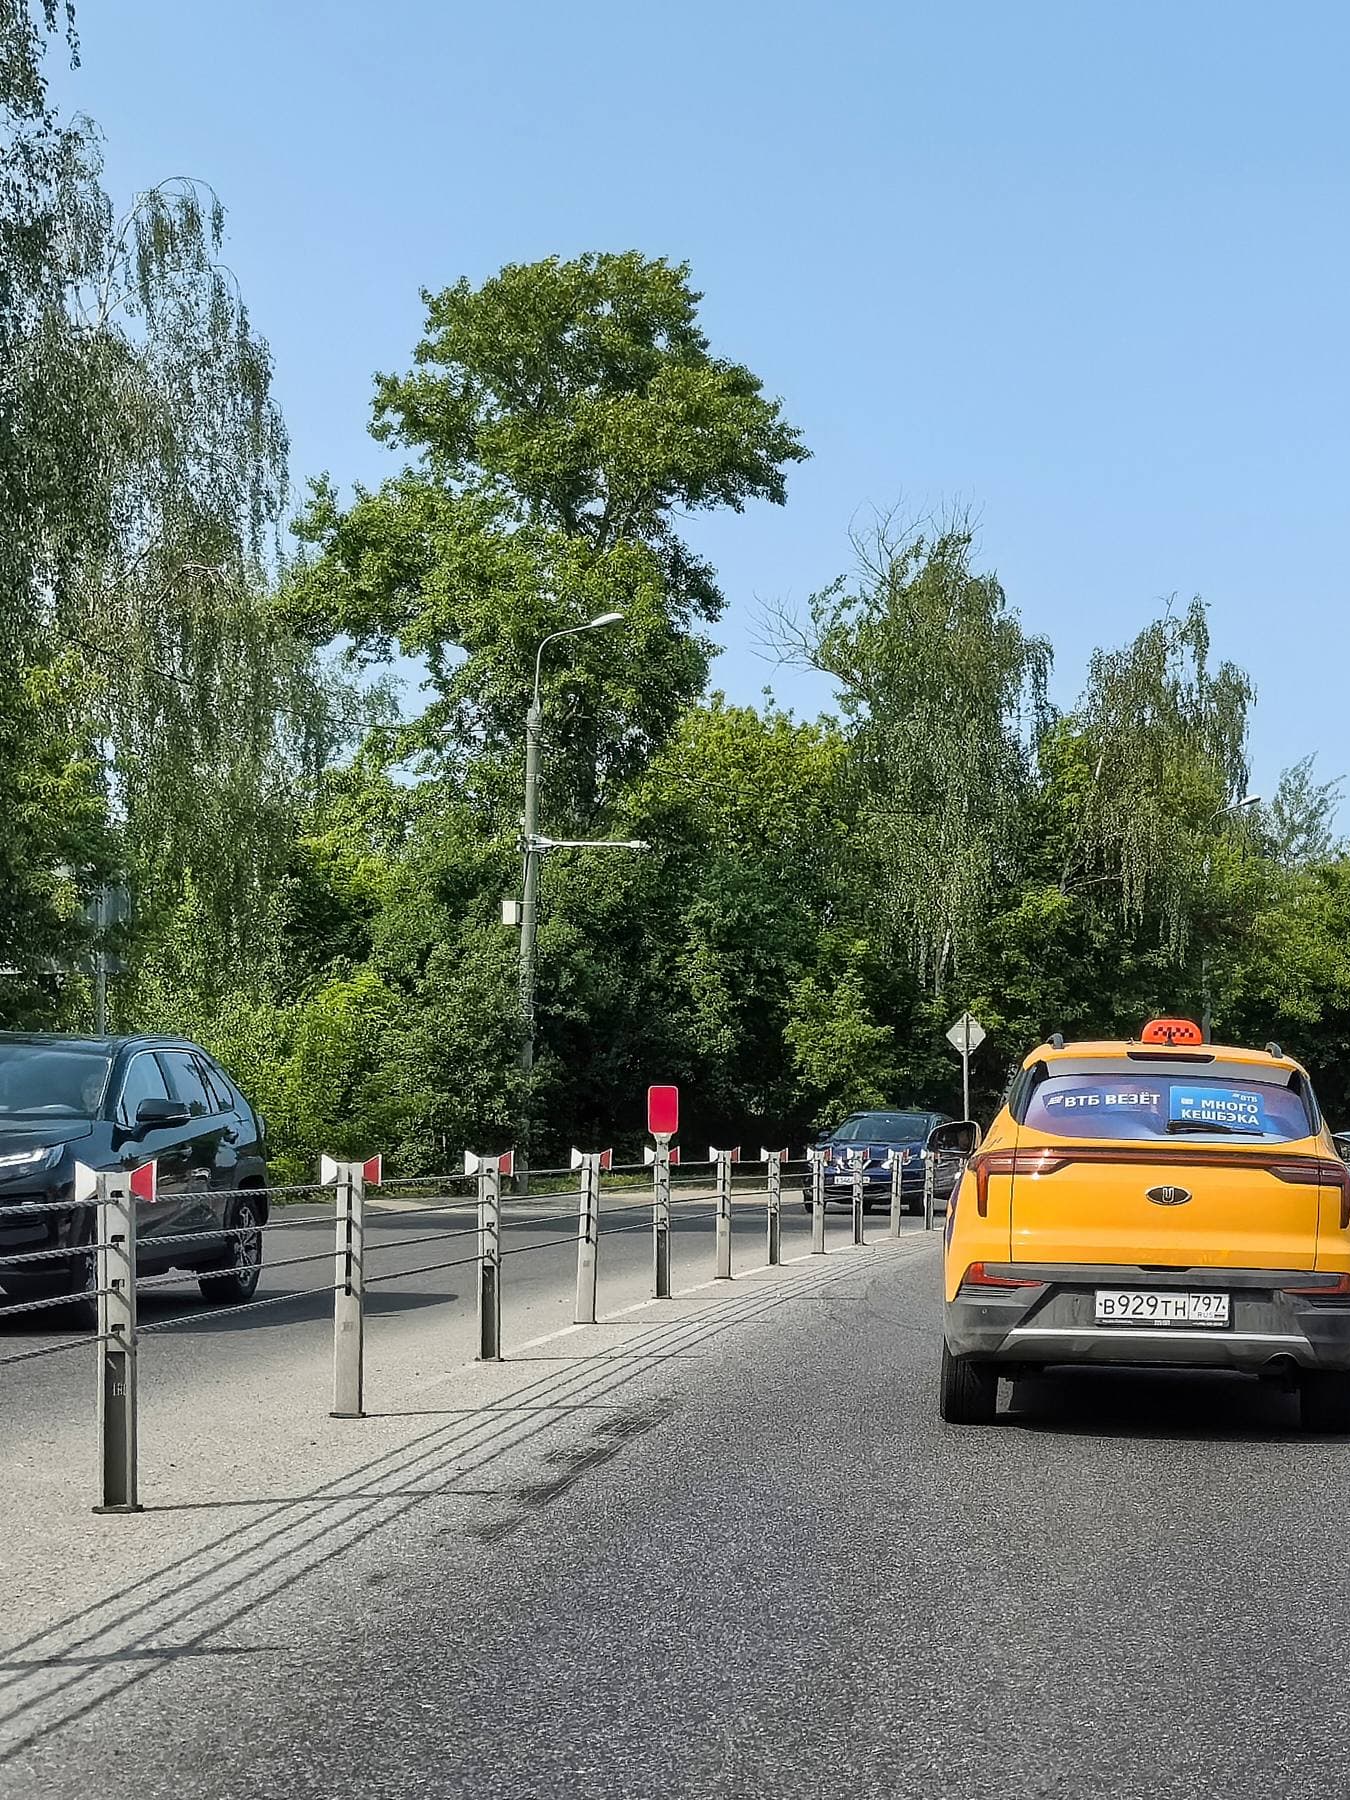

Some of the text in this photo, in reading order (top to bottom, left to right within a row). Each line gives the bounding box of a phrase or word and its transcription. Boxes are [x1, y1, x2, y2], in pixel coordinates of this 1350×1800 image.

[1064, 1091, 1160, 1107] ВТБ ВЕЗЁТ
[1201, 1099, 1258, 1114] МНОГО
[1241, 1095, 1258, 1103] ВТБ
[1181, 1109, 1259, 1125] КЕШБЭКА
[1103, 1295, 1222, 1316] В929ТН 797
